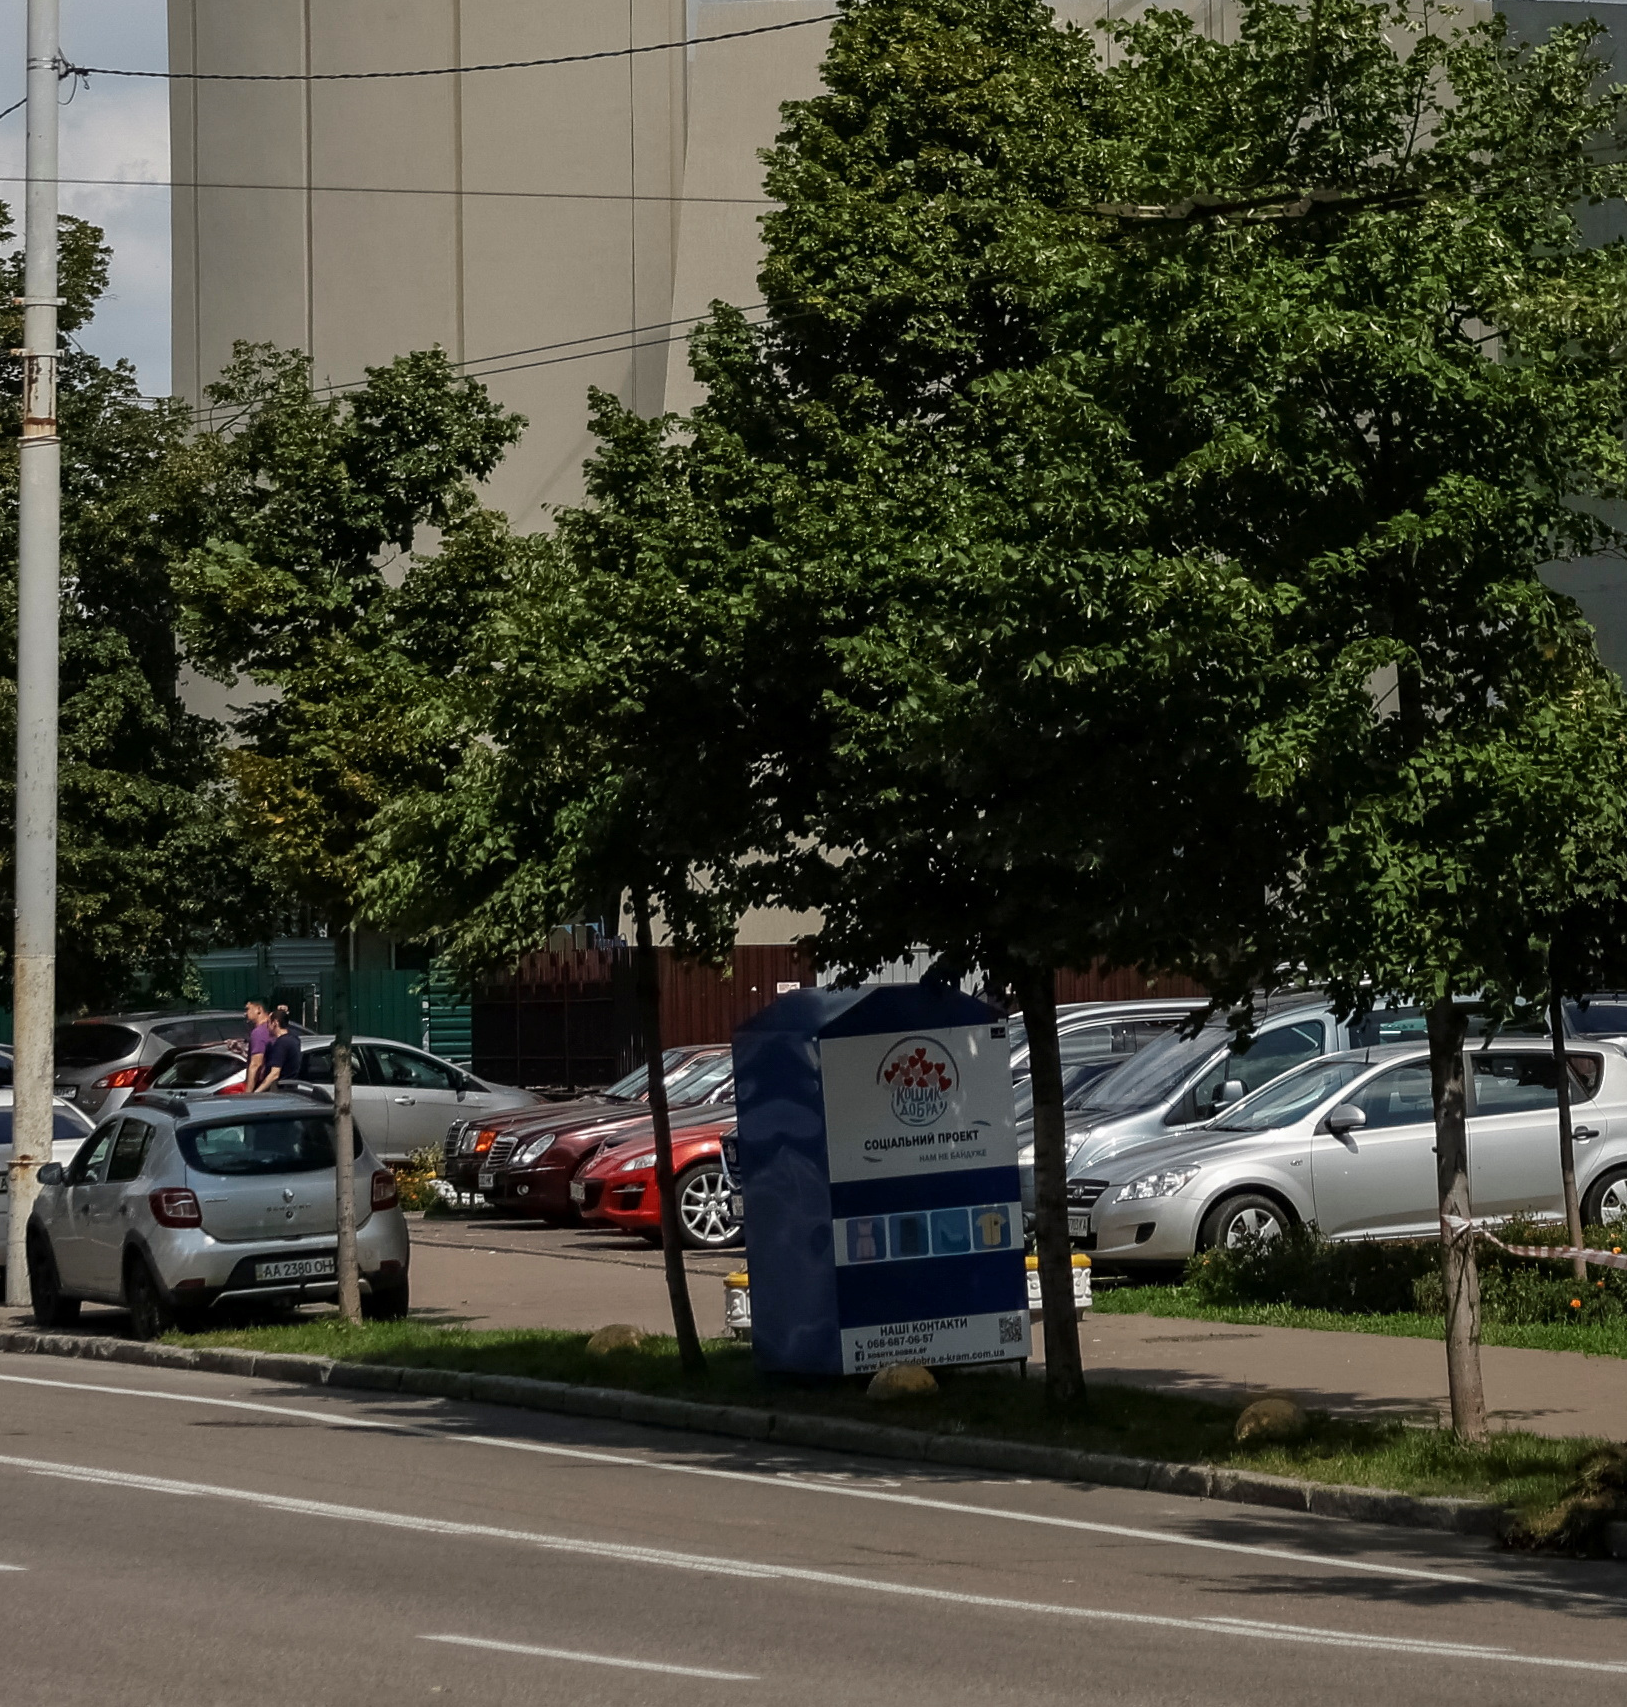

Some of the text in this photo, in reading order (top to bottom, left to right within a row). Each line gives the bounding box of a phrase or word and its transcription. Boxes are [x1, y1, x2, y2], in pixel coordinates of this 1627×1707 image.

[896, 1086, 941, 1106] КОШИК
[900, 1102, 939, 1117] ДОБРА
[864, 1130, 979, 1151] СОЦІАЛЬНИЙ ПРОЕКТ
[919, 1149, 987, 1163] НАМ НЕ БАЙДУЖЕ
[264, 1260, 334, 1278] AA 2380 OH
[880, 1318, 968, 1336] НАШІ КОНТАКТИ
